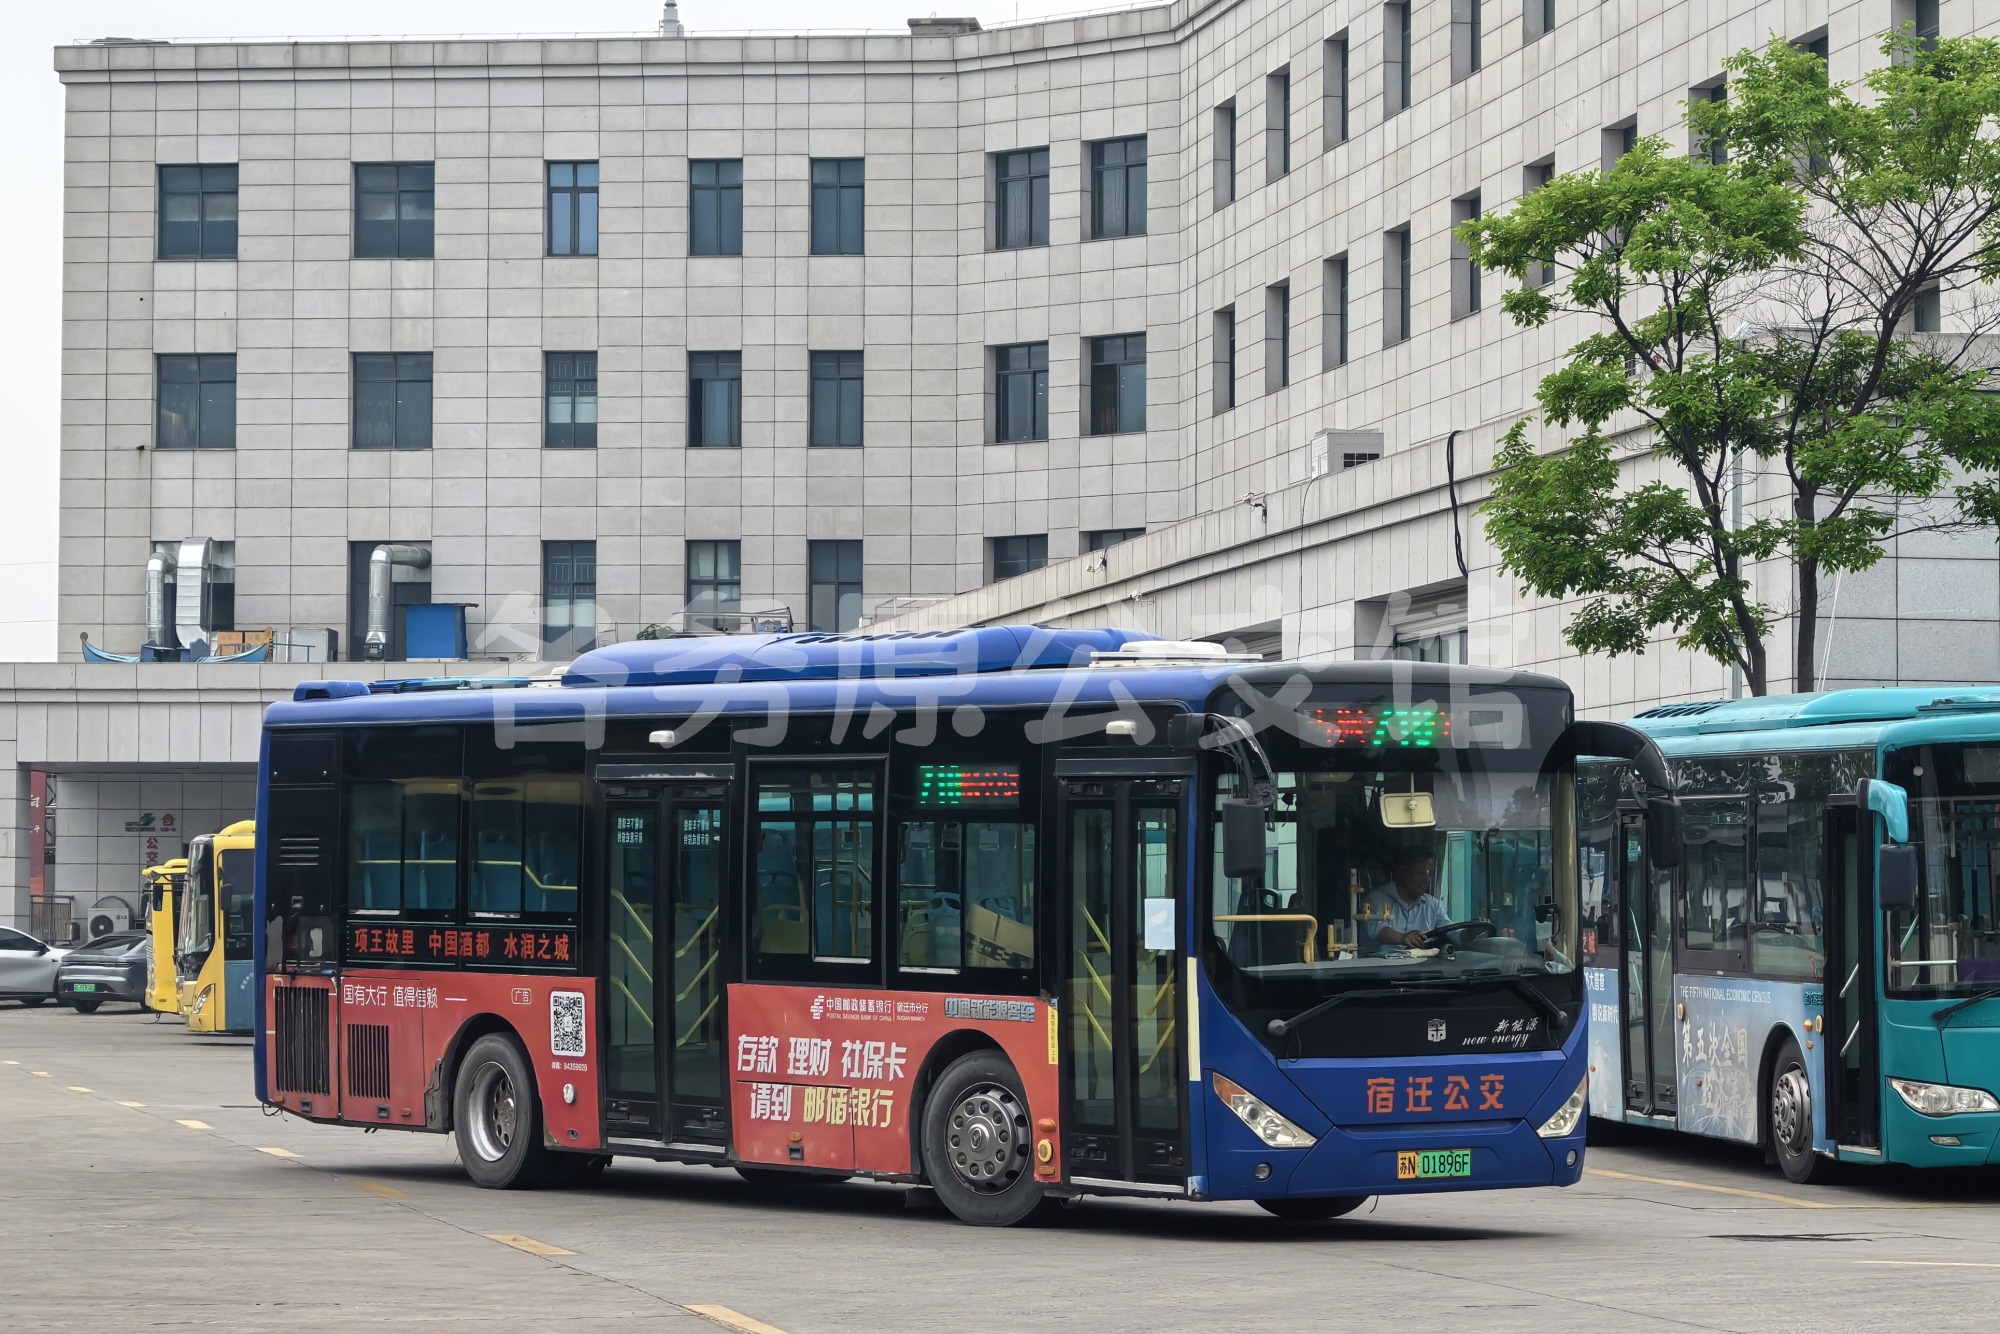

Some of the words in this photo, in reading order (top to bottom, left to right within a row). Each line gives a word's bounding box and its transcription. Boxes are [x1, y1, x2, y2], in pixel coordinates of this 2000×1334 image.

[146, 837, 158, 868] 公交
[354, 928, 415, 954] 项王故里
[428, 930, 490, 957] 中国酒都
[503, 932, 569, 961] 水润之城
[343, 984, 387, 1006] 国有大行
[392, 985, 438, 1008] 值得信赖
[513, 989, 530, 1004] 广告
[1680, 985, 1689, 998] THE
[826, 996, 892, 1014] 中国邮政储蓄银行
[896, 1001, 929, 1014] 宿迁市分行
[1494, 1017, 1538, 1034] 新能源
[1462, 1036, 1489, 1046] new
[1491, 1033, 1530, 1048] energy
[737, 1034, 779, 1073] 存款
[787, 1037, 832, 1076] 理财
[841, 1039, 907, 1082] 社保卡
[1367, 1073, 1505, 1113] 宿迁公交
[750, 1083, 792, 1121] 请到
[803, 1087, 894, 1128] 邮储银行
[1399, 1156, 1416, 1175] 苏N
[1422, 1153, 1470, 1174] 01896F
